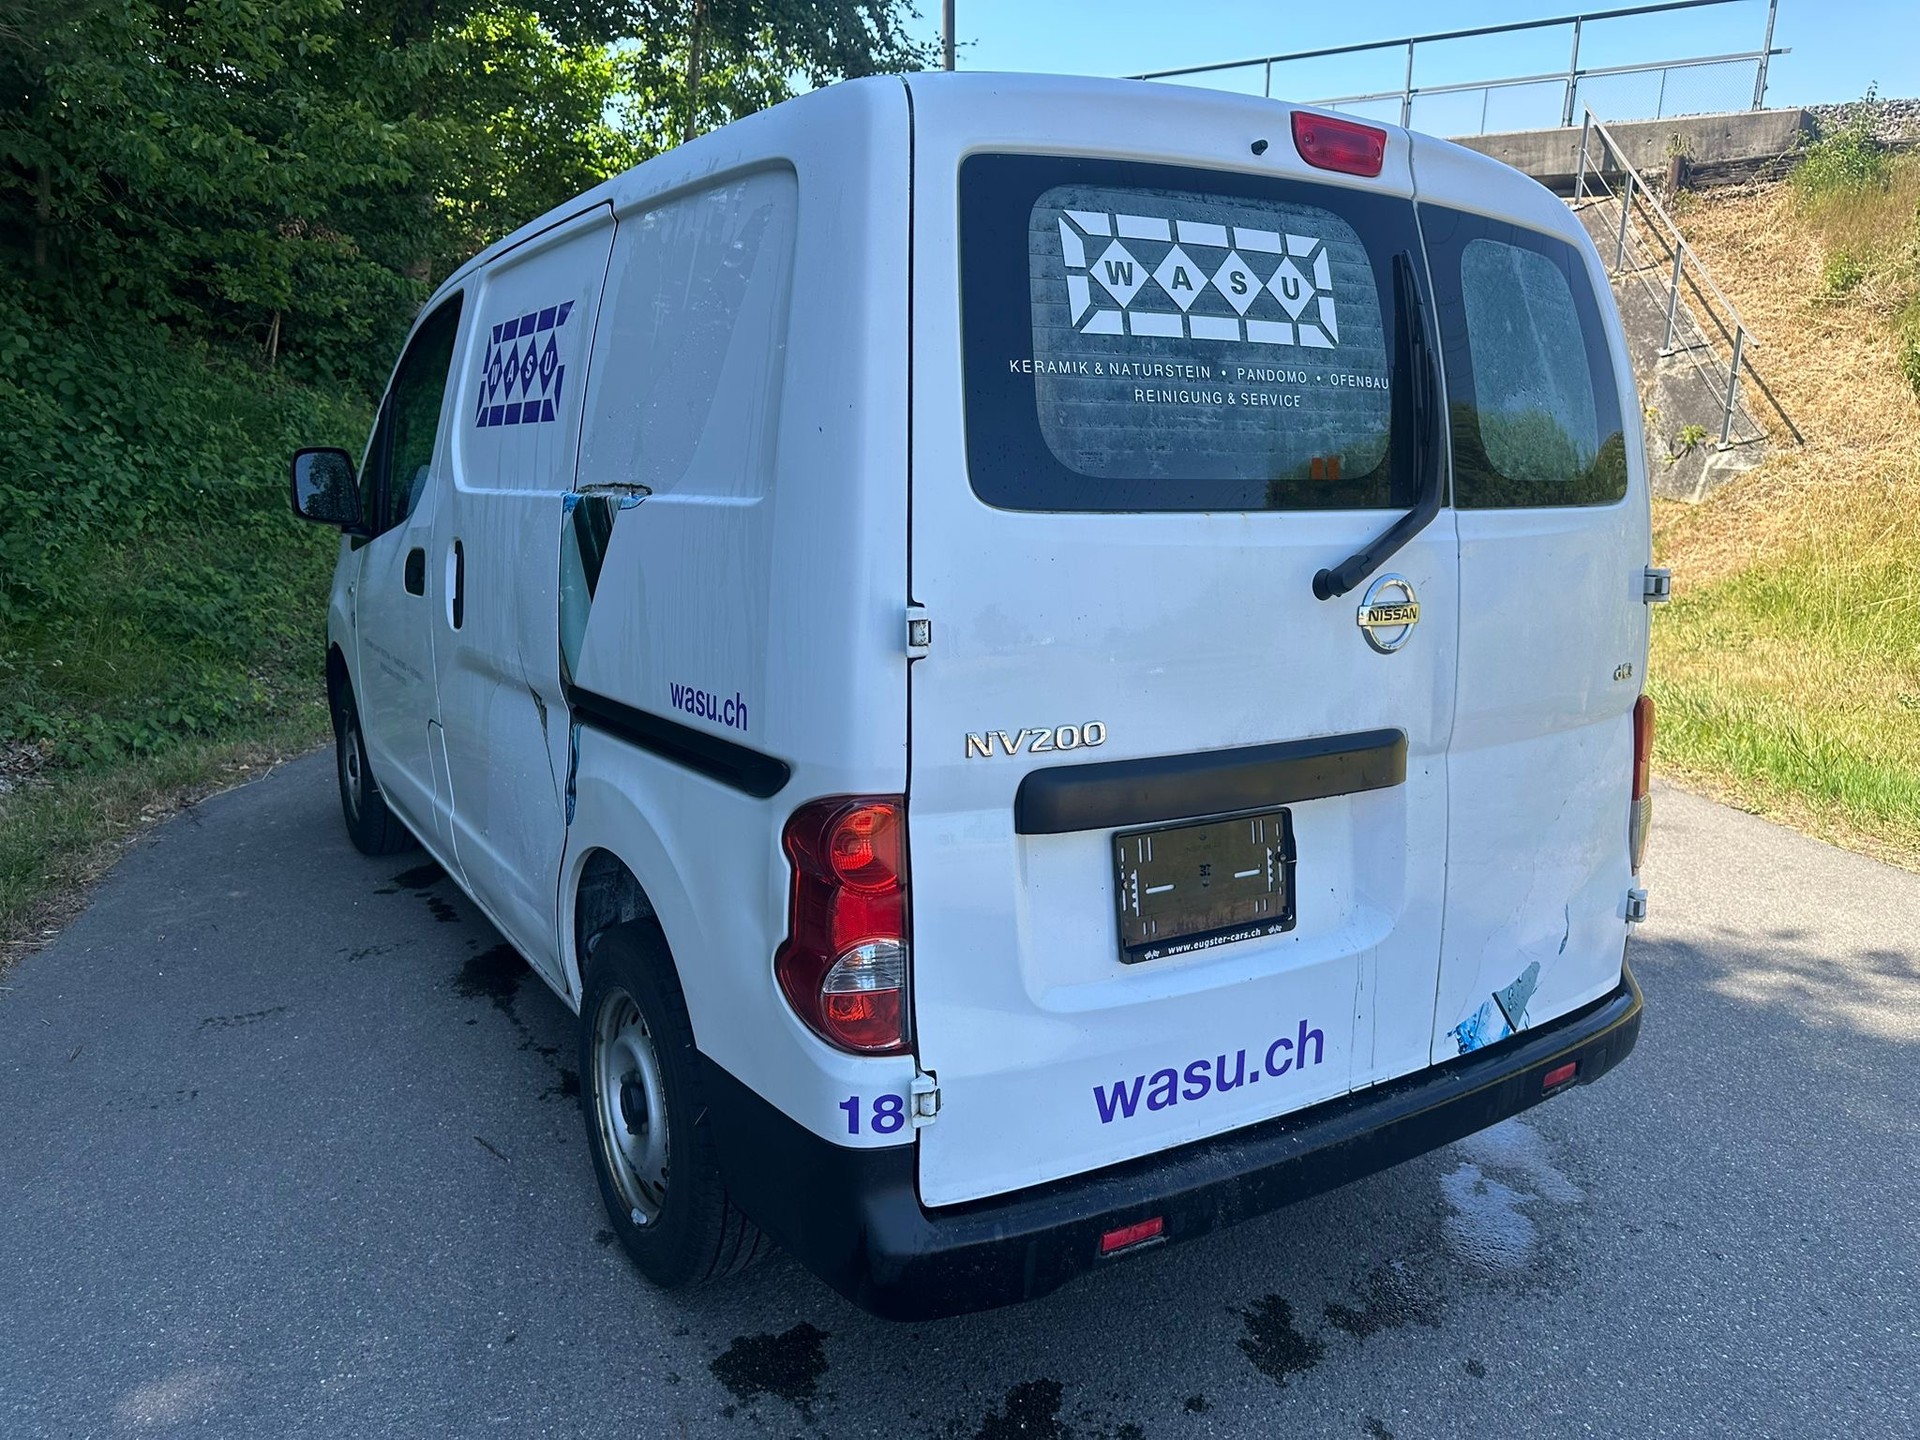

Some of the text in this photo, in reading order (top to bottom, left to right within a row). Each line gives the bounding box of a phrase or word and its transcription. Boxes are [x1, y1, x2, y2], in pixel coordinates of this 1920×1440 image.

[1104, 260, 1300, 301] WASU
[490, 351, 554, 386] WASU
[1009, 360, 1389, 389] KERAMIK & NATURSTEIN PANDOMO OFENBAU
[1134, 389, 1301, 408] REINIGUNG & SERVICE
[1368, 607, 1417, 622] NISSAN
[670, 682, 748, 731] wasu.ch
[965, 720, 1107, 758] NV200
[1168, 927, 1261, 955] www.eugster-cars.ch
[1093, 1019, 1324, 1124] wasu.ch
[839, 1094, 905, 1135] 18
